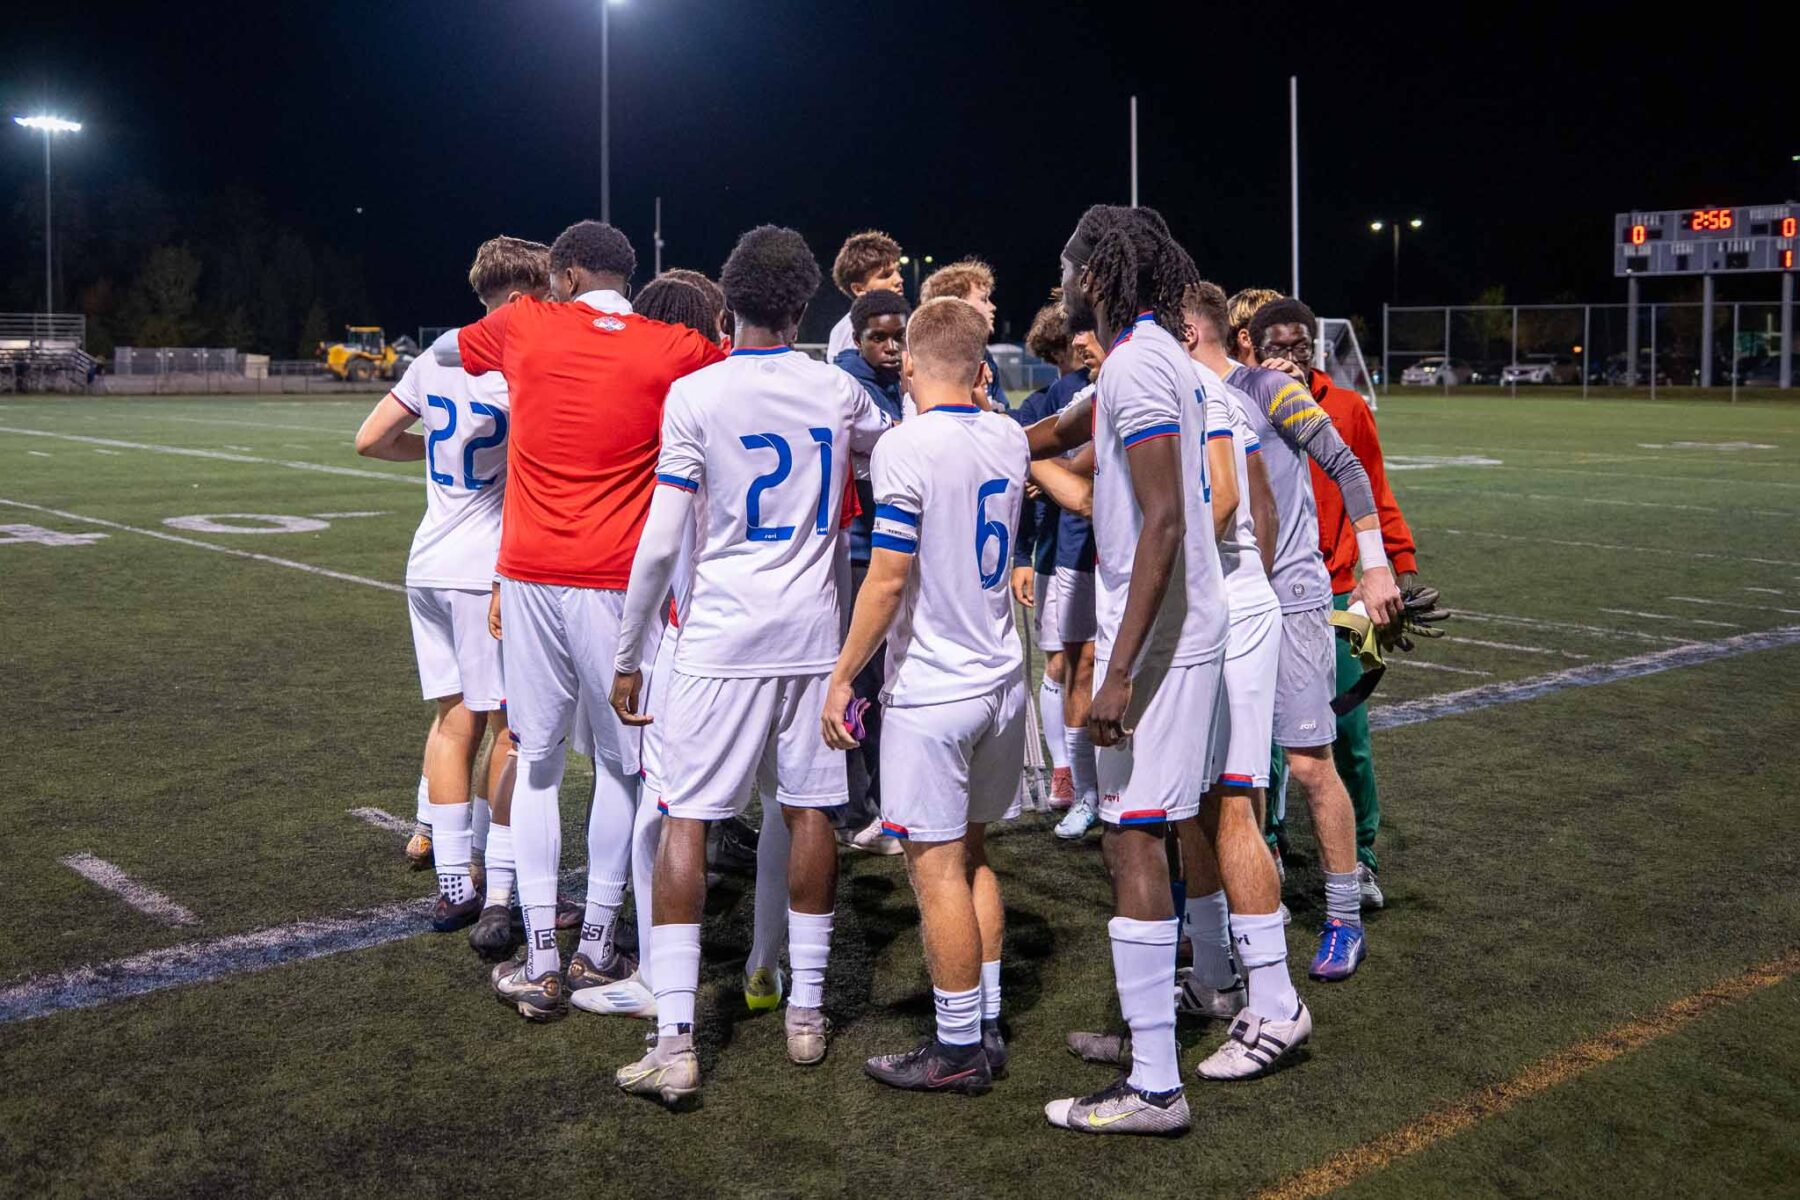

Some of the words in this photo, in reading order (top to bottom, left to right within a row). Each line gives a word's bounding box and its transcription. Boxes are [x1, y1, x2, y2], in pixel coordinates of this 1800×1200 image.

[1692, 210, 1732, 231] 2:56
[1782, 217, 1796, 238] 0
[1632, 225, 1646, 245] 0
[1785, 250, 1793, 268] 1
[426, 394, 508, 490] 22
[739, 427, 833, 542] 21
[976, 478, 1010, 591] 6
